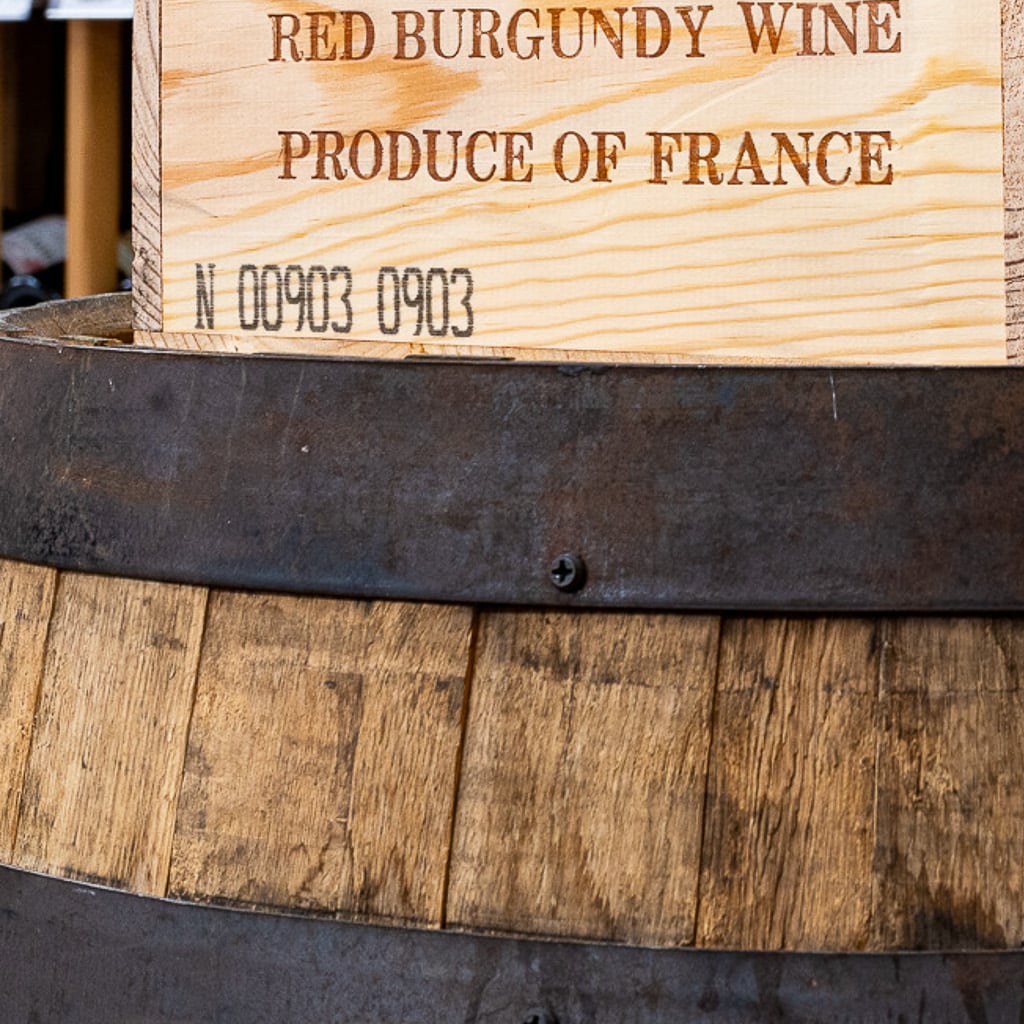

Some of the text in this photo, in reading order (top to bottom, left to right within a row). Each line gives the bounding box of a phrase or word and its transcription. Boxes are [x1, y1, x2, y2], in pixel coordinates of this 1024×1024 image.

[266, 9, 376, 62] RED
[391, 4, 714, 61] BURGUNDY
[276, 129, 895, 187] PRODUCE OF FRANCE
[237, 264, 353, 333] 00903
[377, 266, 474, 338] 0903
